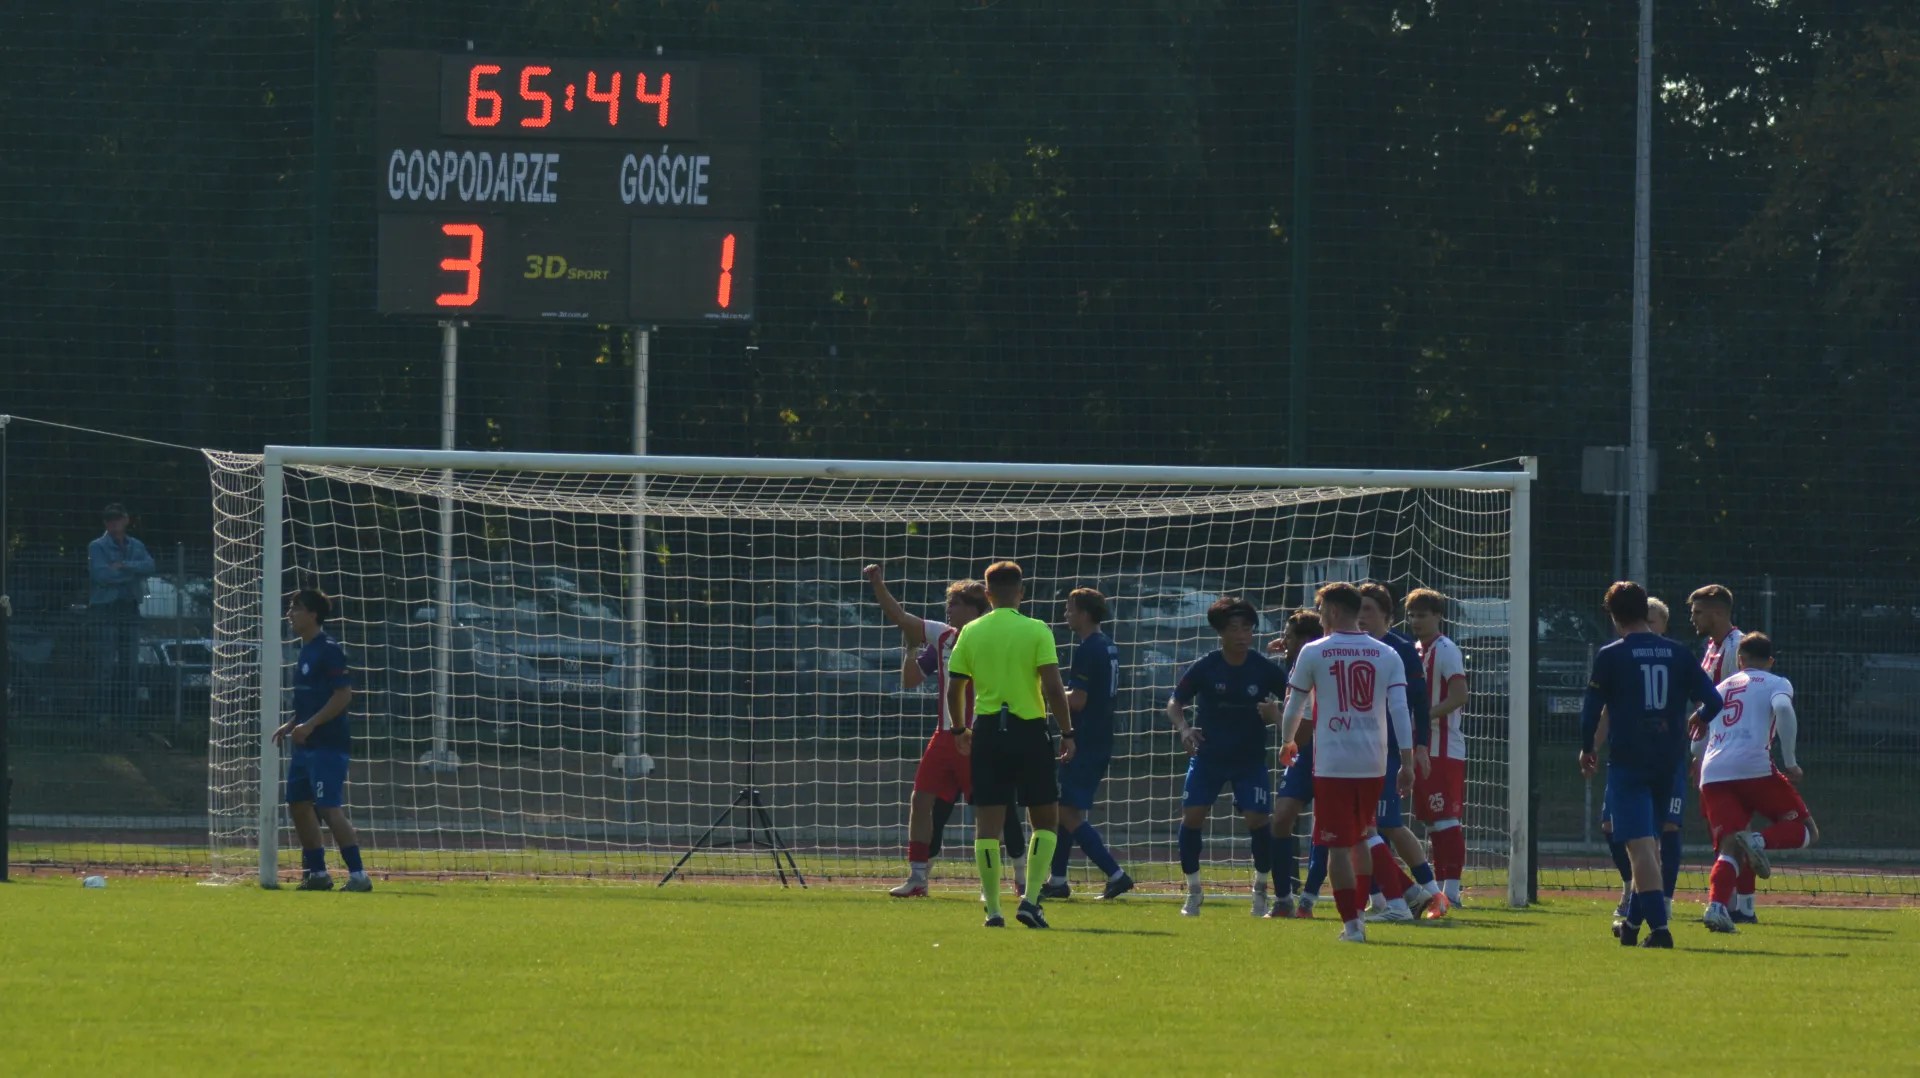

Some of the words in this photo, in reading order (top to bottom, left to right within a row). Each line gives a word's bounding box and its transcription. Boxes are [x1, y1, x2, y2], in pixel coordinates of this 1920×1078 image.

[466, 64, 671, 128] 65:44
[388, 149, 560, 203] GOSPODARZE
[620, 145, 710, 205] GOŚCIE
[436, 223, 484, 307] 3
[523, 255, 568, 280] 3D
[717, 233, 735, 308] 1
[1322, 648, 1360, 658] OSTROVIA
[1362, 649, 1380, 658] 1909
[1329, 660, 1376, 713] 10
[1640, 663, 1668, 710] 10
[1722, 685, 1748, 727] 5
[316, 781, 324, 798] 2
[1253, 786, 1267, 804] 14
[1428, 792, 1445, 809] 25
[1669, 797, 1682, 815] 19
